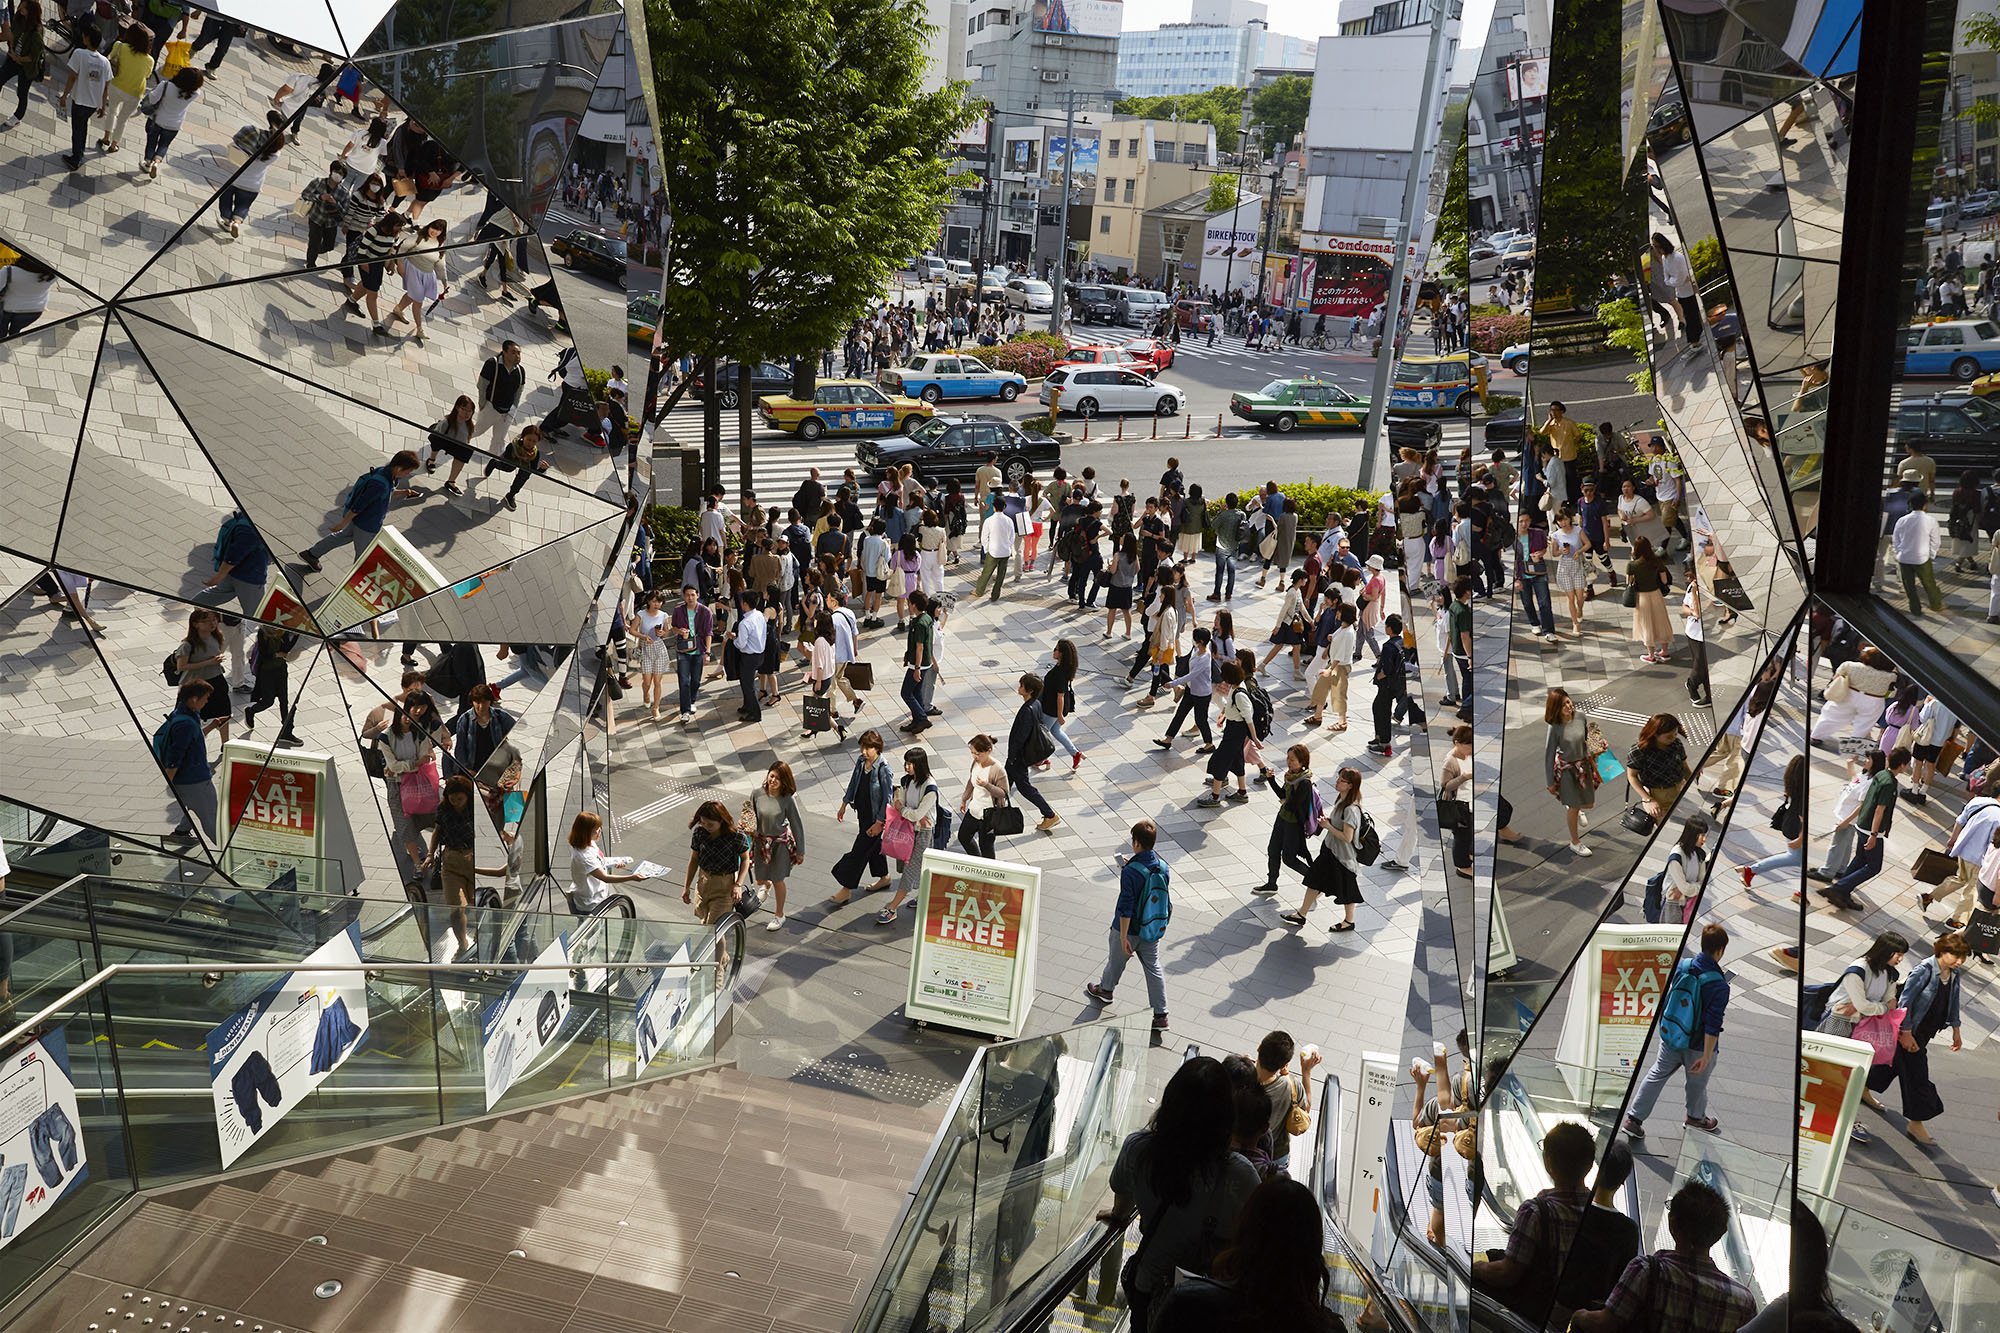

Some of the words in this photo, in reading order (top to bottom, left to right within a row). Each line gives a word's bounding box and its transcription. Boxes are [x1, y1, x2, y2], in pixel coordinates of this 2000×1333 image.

[1207, 229, 1256, 242] BIRKENSTOCK
[952, 864, 1006, 879] INFORMATION
[944, 891, 1008, 925] TAX
[940, 914, 1006, 948] FREE
[944, 978, 959, 987] VISA
